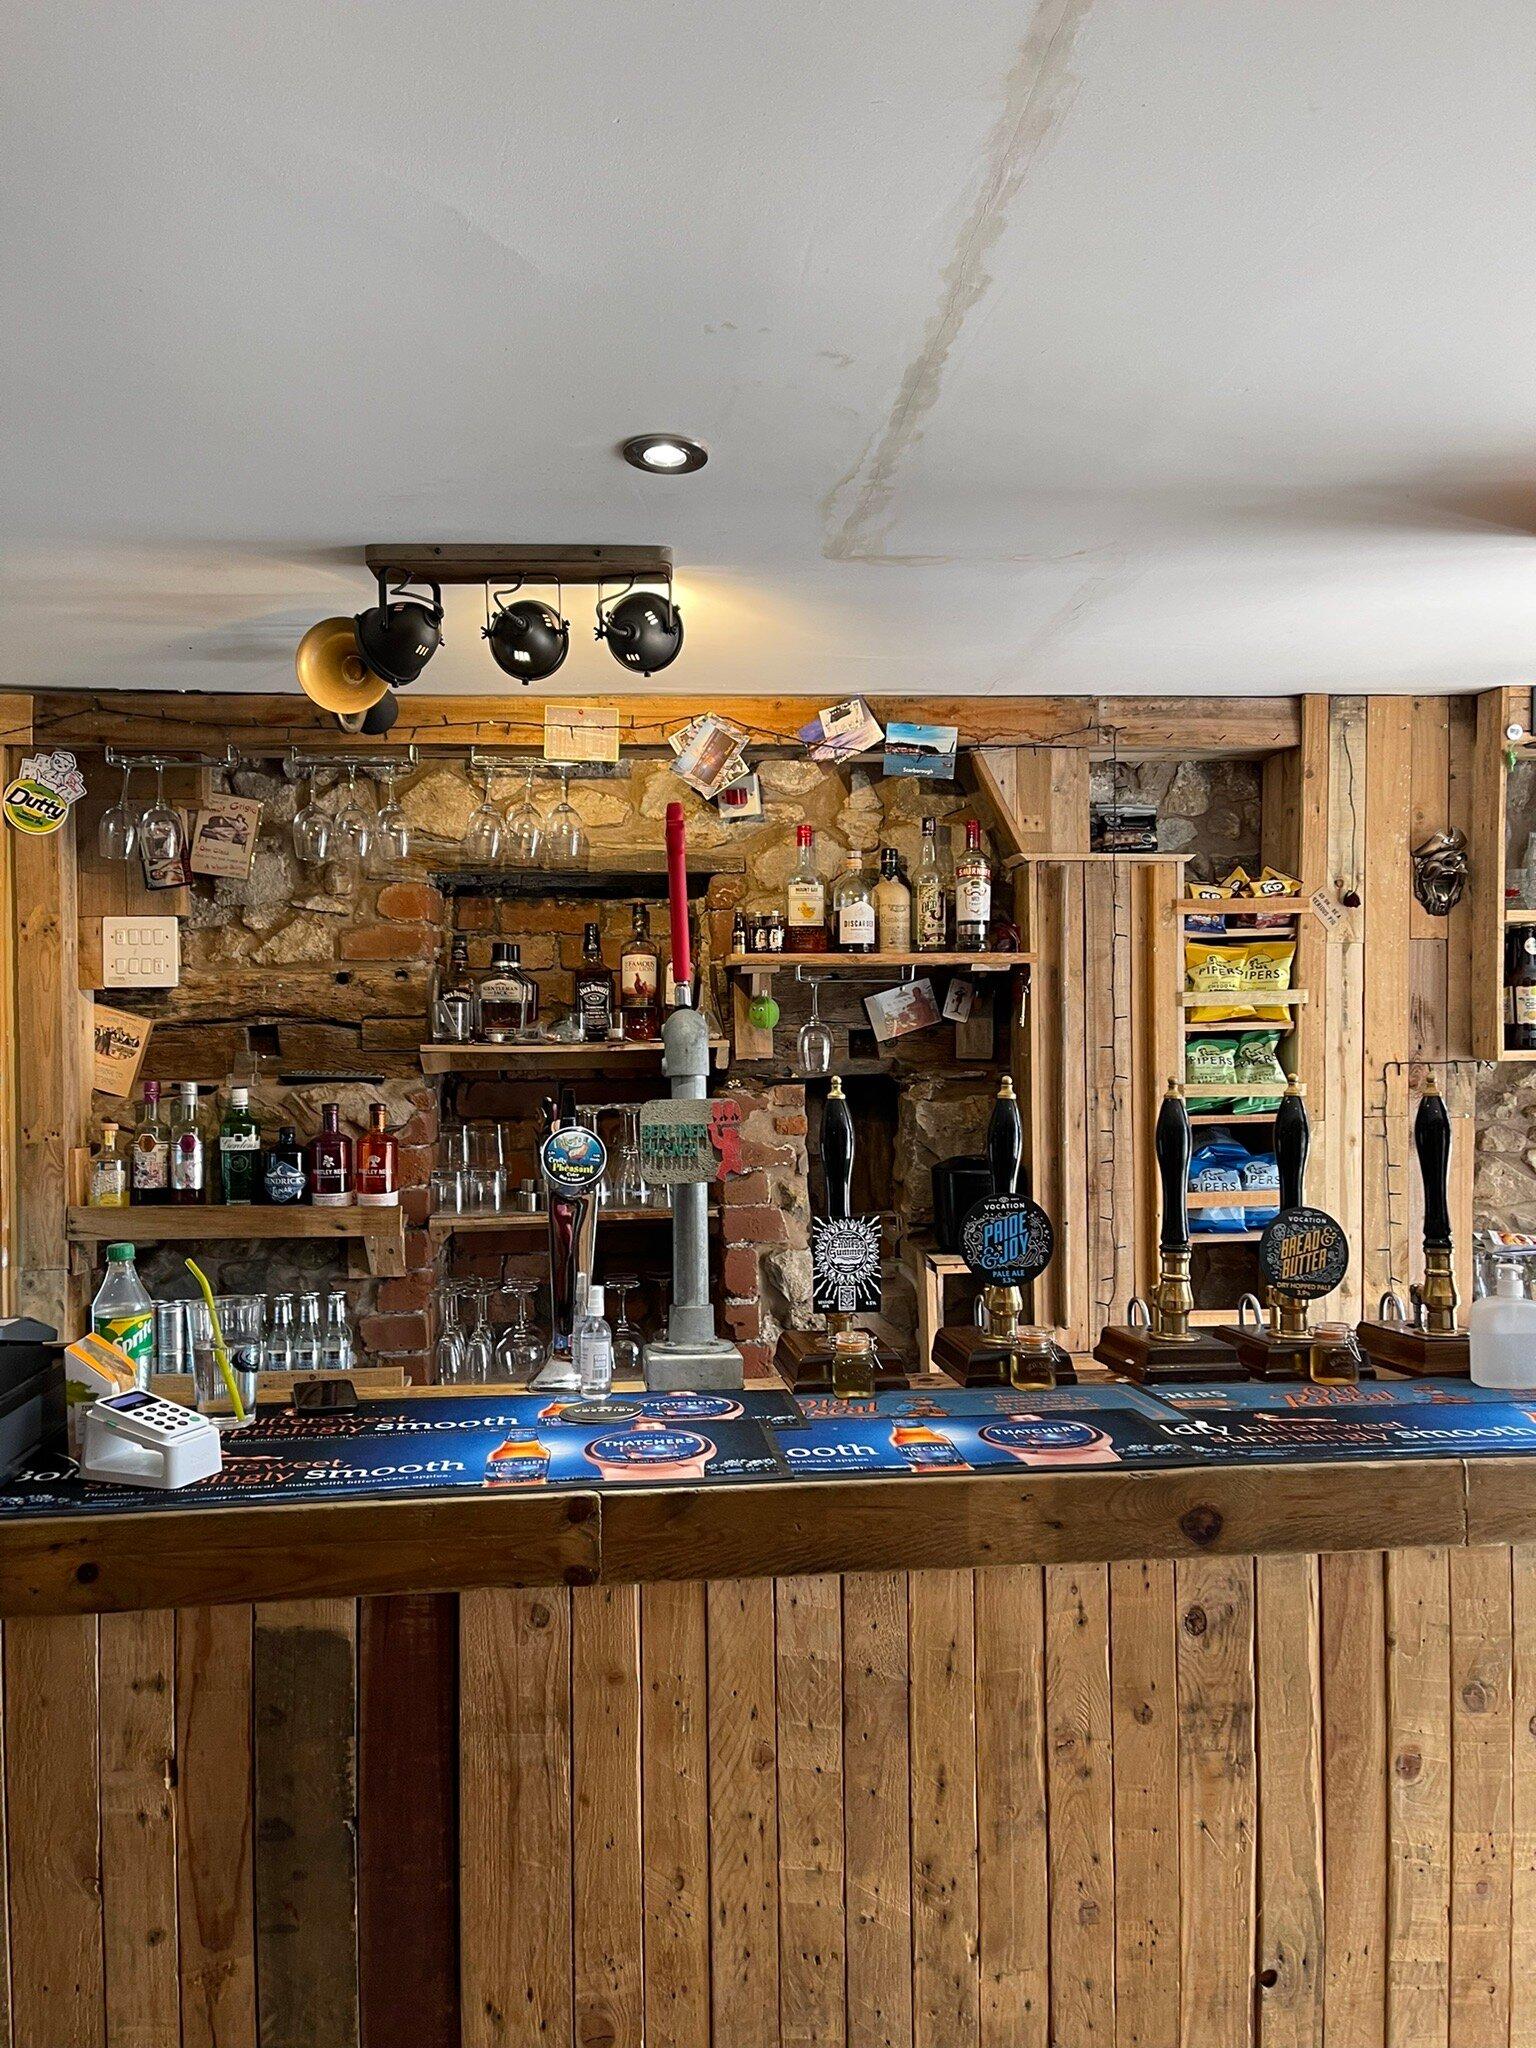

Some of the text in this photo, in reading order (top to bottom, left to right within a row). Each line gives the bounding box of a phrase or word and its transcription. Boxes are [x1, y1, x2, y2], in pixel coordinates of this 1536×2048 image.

[902, 766, 934, 775] Scarborough
[5, 787, 66, 820] Dutty
[1263, 884, 1283, 893] KP
[1199, 965, 1243, 976] PIPERS
[1244, 968, 1280, 980] IPERS
[1188, 1056, 1233, 1066] PIPERS
[552, 1162, 595, 1174] Pheasant
[1245, 1174, 1281, 1185] IPERS
[1191, 1181, 1237, 1192] PIPERS
[984, 1202, 1025, 1211] VOCATION
[1288, 1216, 1327, 1224] VOCATION
[984, 1210, 1028, 1247] PRIDE
[1280, 1226, 1338, 1260] BREAD &
[828, 1247, 867, 1258] Summer
[981, 1231, 1030, 1270] & JOY
[1281, 1248, 1328, 1280] BUTTER
[1277, 1281, 1289, 1289] DRY
[1290, 1282, 1316, 1290] HOPPED
[643, 1400, 723, 1408] THATCHERS
[374, 1416, 520, 1431] smooth
[991, 1425, 1082, 1436] THATCHERS
[1210, 1431, 1389, 1444] surprisingly
[1394, 1425, 1536, 1439] smooth
[602, 1437, 694, 1448] THATCHERS
[785, 1443, 879, 1458] ooth
[304, 1459, 467, 1480] smooth
[490, 1460, 548, 1468] THATCHERS
[346, 1474, 409, 1485] bittersweet
[412, 1472, 452, 1481] apples.
